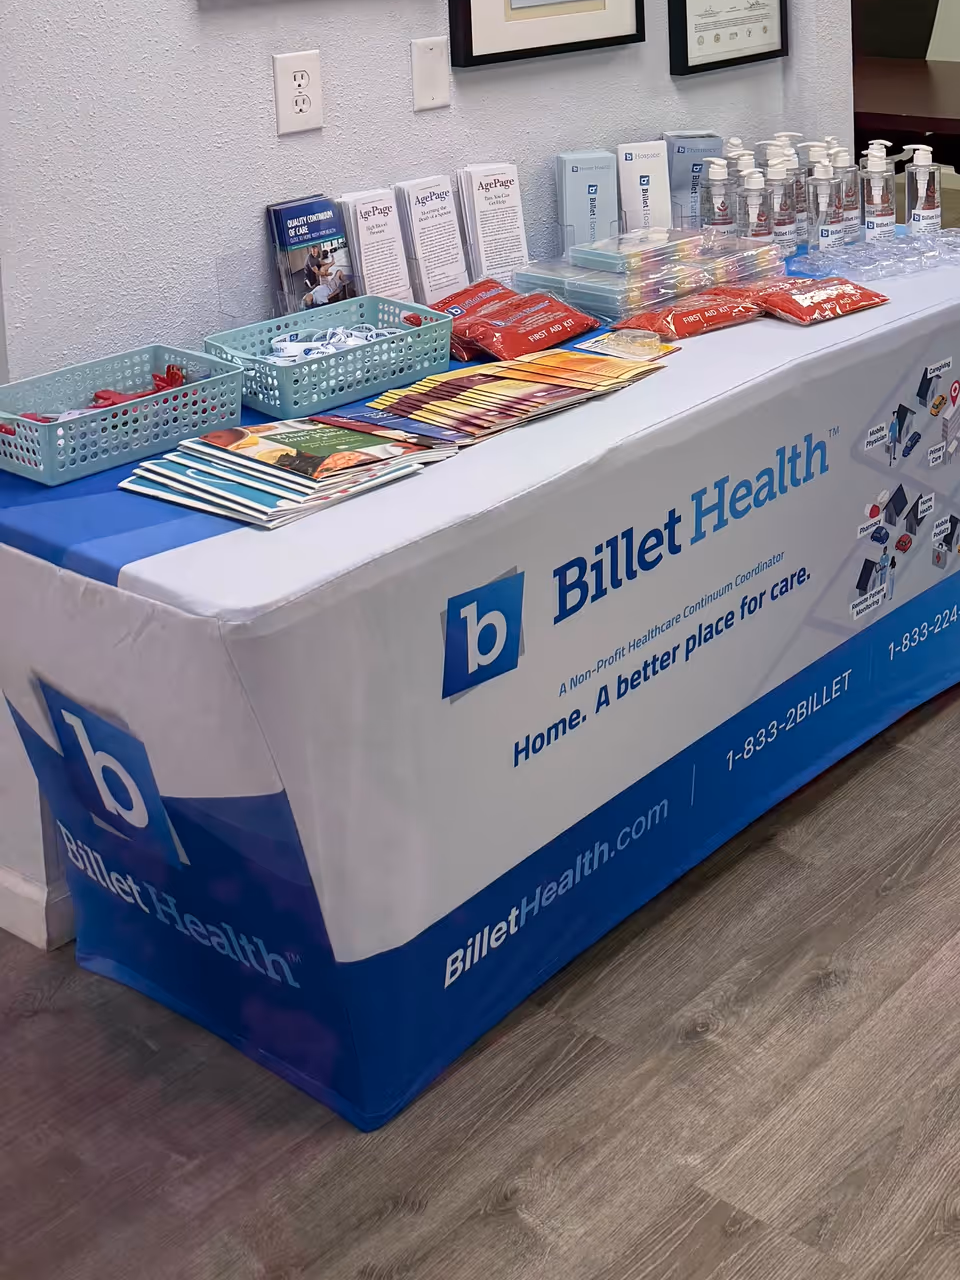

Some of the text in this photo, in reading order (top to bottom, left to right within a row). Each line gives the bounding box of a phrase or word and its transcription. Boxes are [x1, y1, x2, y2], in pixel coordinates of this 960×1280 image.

[477, 178, 515, 192] AgePage
[691, 175, 700, 194] Billet
[415, 190, 450, 207] AgePage
[589, 197, 597, 217] Billet
[287, 216, 307, 228] QUALITY
[288, 229, 296, 237] OF
[296, 225, 309, 235] CARE
[839, 297, 851, 305] AID
[682, 306, 729, 324] FIRST AID KIT
[528, 330, 548, 343] FIRST
[549, 324, 563, 334] AID
[564, 319, 575, 328] KIT
[929, 361, 951, 375] Caregiving
[869, 425, 885, 437] Mobile
[866, 433, 887, 448] Physician
[929, 445, 945, 456] Primary
[931, 455, 942, 464] Care
[920, 497, 933, 506] Home
[920, 505, 933, 514] Health
[553, 508, 682, 625] Billet
[690, 432, 829, 546] Health
[860, 520, 881, 535] Pharmacy
[933, 526, 949, 539] Podiatry
[935, 518, 948, 530] Mobile
[851, 586, 885, 611] Remote Patient
[856, 599, 880, 617] Monitoring
[558, 550, 786, 698] A Non-Profit Healthcare Continuum Coordinator
[460, 601, 508, 674] b
[513, 566, 811, 768] Home. A better place for care.
[726, 669, 853, 772] 1-833-2BILLET
[60, 709, 149, 829] b
[444, 796, 669, 991] BilletHealth.com
[56, 819, 150, 914] Billet
[143, 880, 301, 989] Health
